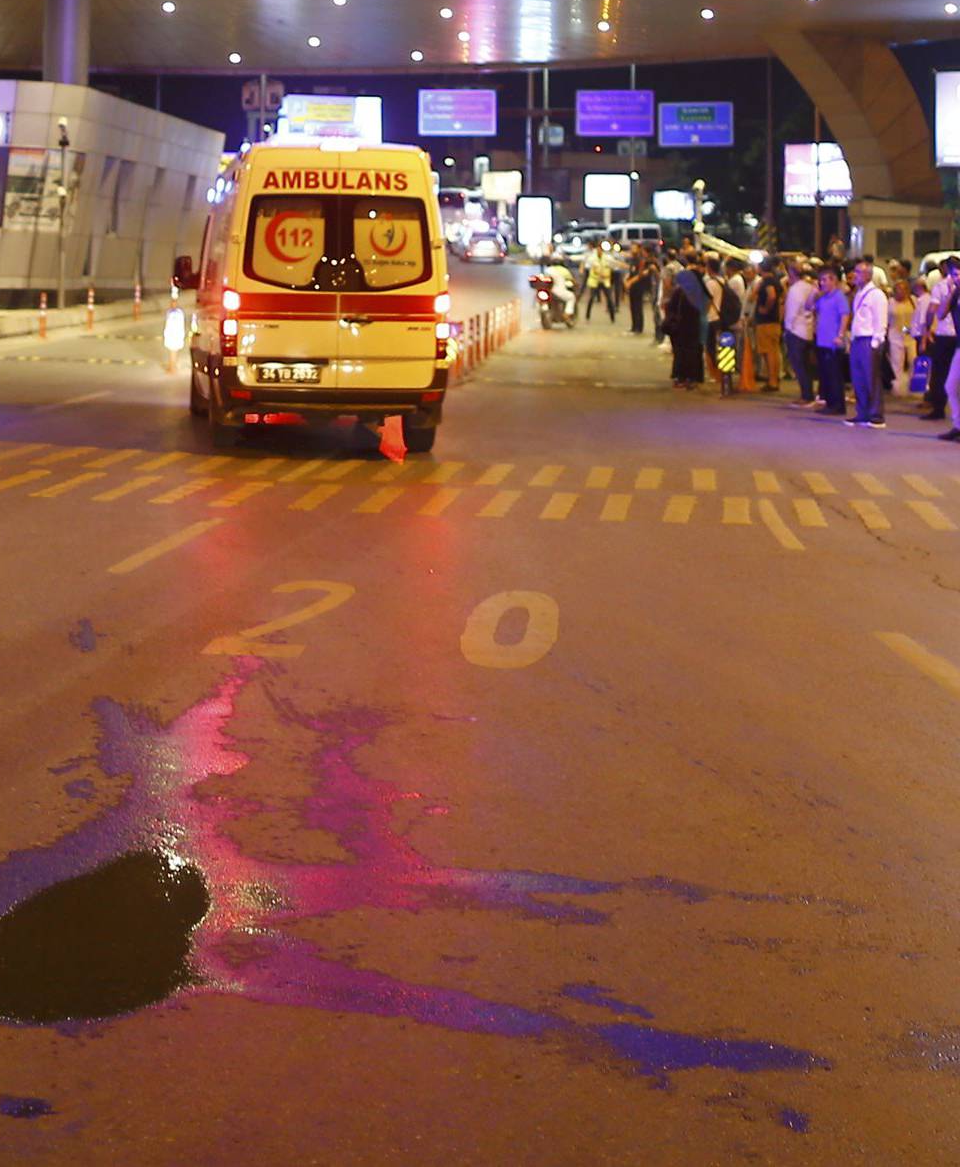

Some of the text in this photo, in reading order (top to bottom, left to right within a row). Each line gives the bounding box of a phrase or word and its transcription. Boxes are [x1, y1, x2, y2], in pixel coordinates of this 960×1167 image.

[262, 170, 409, 191] AMBULANS
[278, 227, 313, 248] 112
[262, 368, 276, 379] 34
[200, 579, 559, 669] 20
